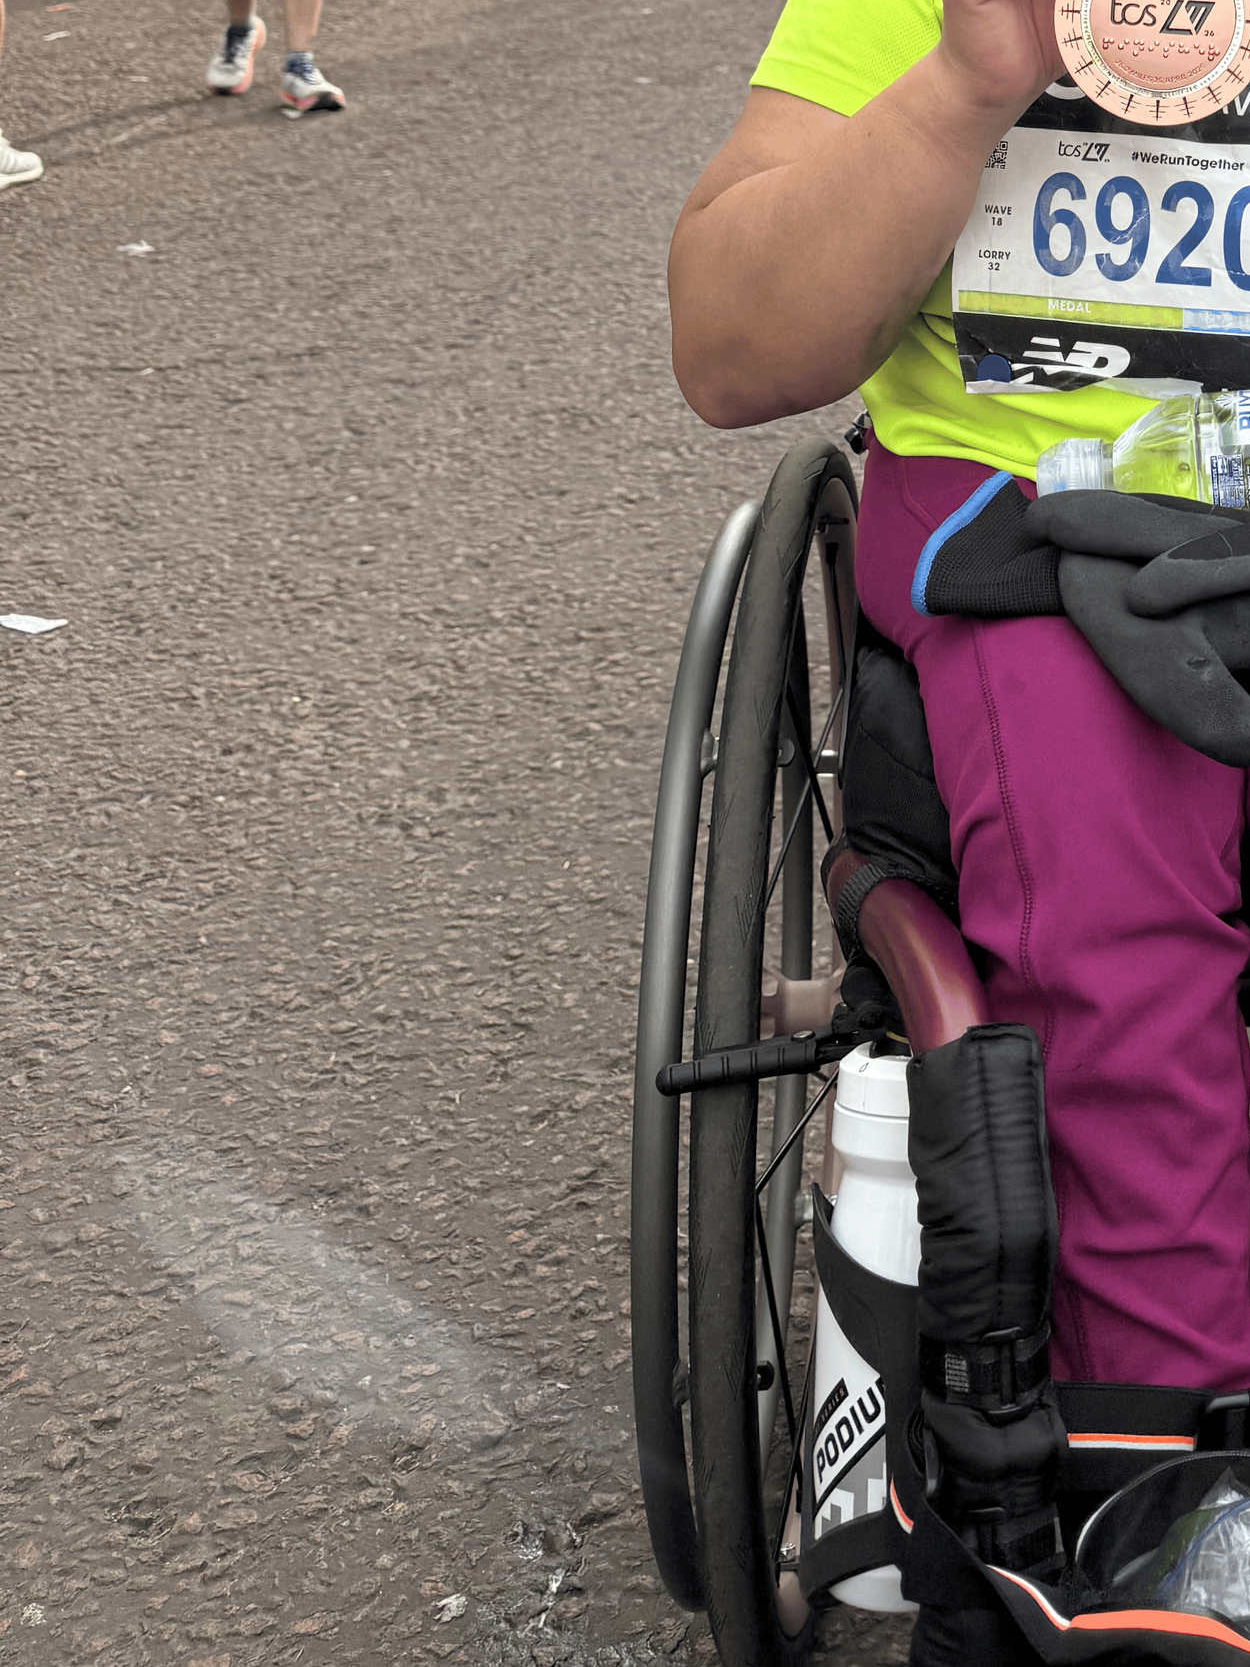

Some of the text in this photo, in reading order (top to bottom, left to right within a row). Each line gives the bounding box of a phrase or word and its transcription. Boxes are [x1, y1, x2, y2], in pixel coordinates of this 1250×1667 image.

[1058, 141, 1081, 157] tcs
[1131, 151, 1245, 172] #WeRunTogether
[985, 204, 1012, 215] WAVE
[992, 216, 1003, 226] 18
[978, 249, 1011, 260] LORRY
[988, 262, 1000, 271] 32
[1048, 299, 1092, 314] MEDAL
[816, 1378, 885, 1484] PODIU
